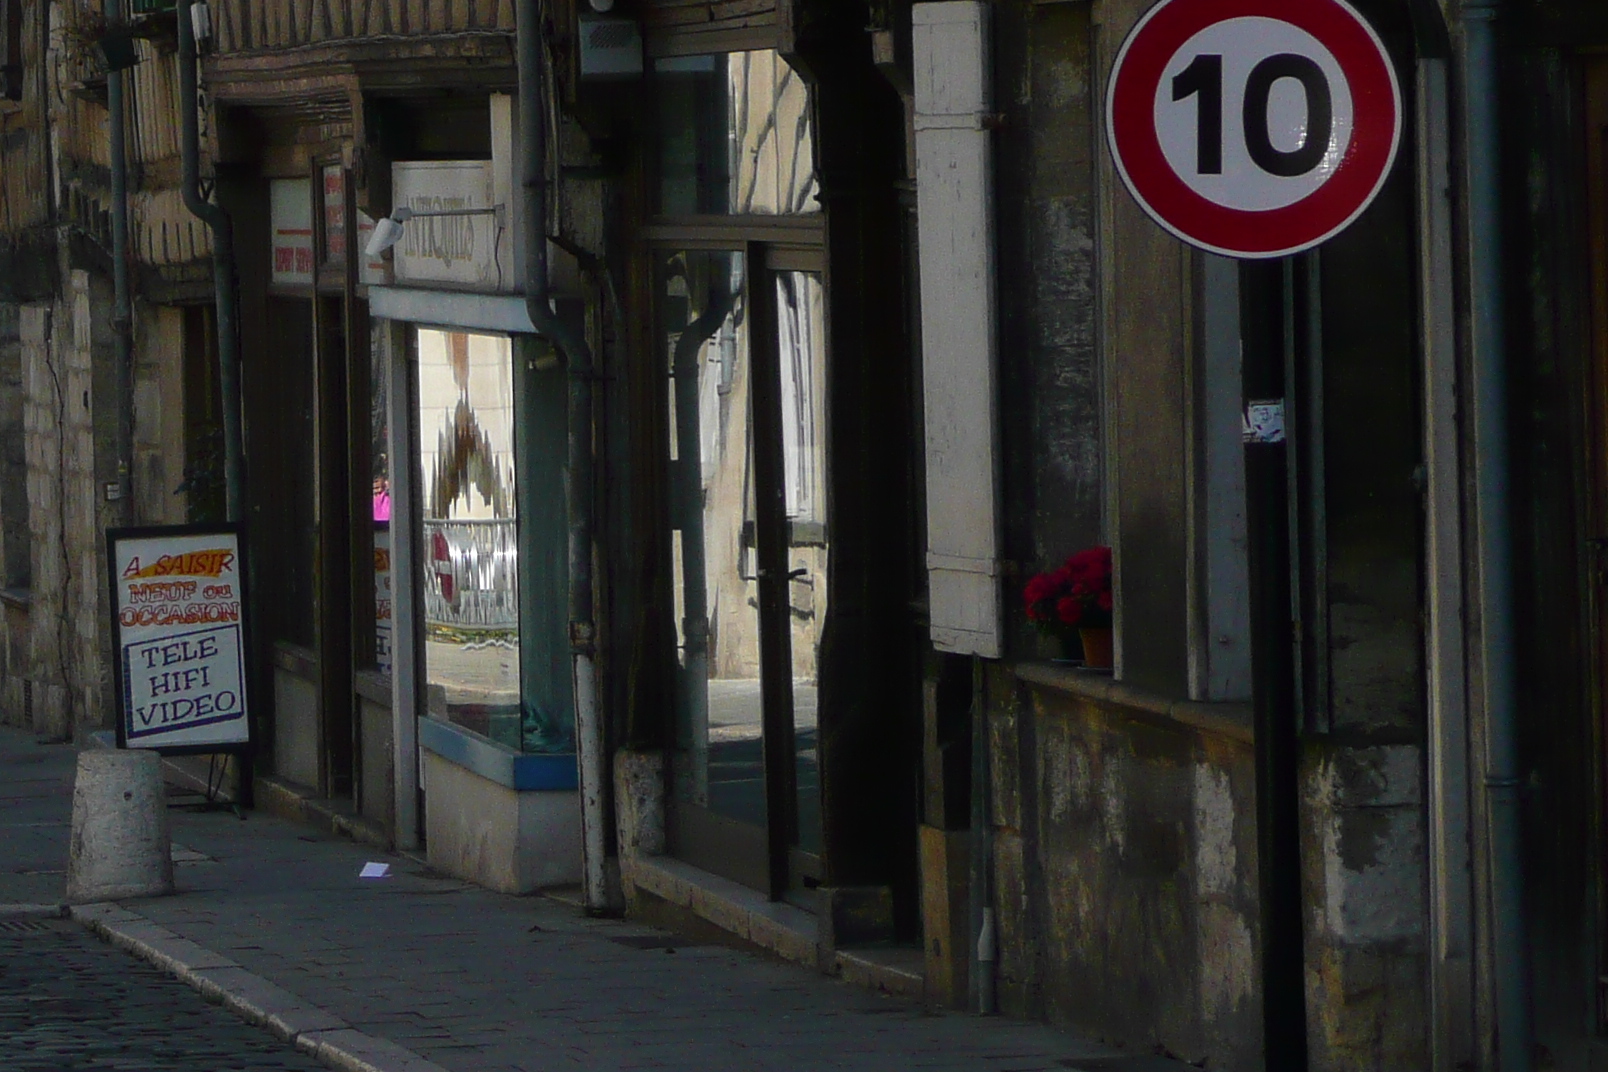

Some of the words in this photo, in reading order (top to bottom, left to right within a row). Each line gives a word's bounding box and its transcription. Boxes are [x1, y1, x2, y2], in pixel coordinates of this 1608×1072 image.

[1172, 53, 1332, 177] 10
[122, 556, 141, 576] A
[154, 553, 235, 575] SAISIR
[129, 581, 197, 604] NEUF
[119, 602, 239, 627] OCCASION
[142, 636, 218, 668] TELE
[149, 666, 210, 697] HIFI
[136, 691, 236, 726] VIDEO
